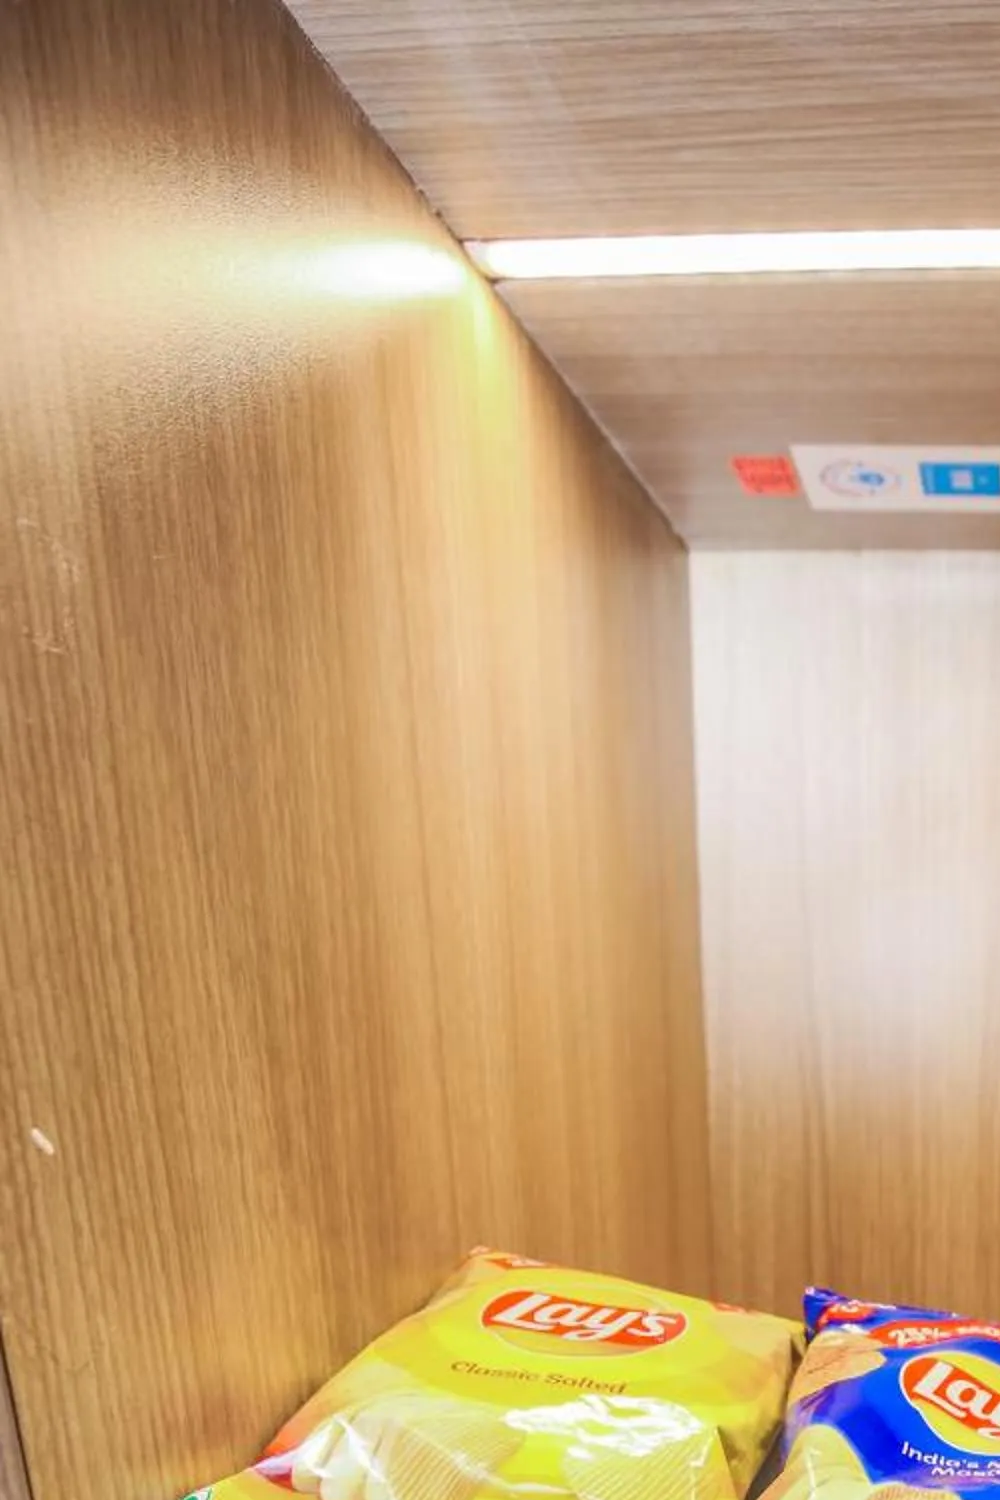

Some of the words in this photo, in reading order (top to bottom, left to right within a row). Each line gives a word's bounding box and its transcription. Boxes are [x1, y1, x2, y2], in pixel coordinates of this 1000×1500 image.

[494, 1292, 678, 1342] Lay's
[450, 1361, 539, 1382] Classic
[544, 1373, 628, 1394] Salted
[901, 1441, 979, 1469] India's
